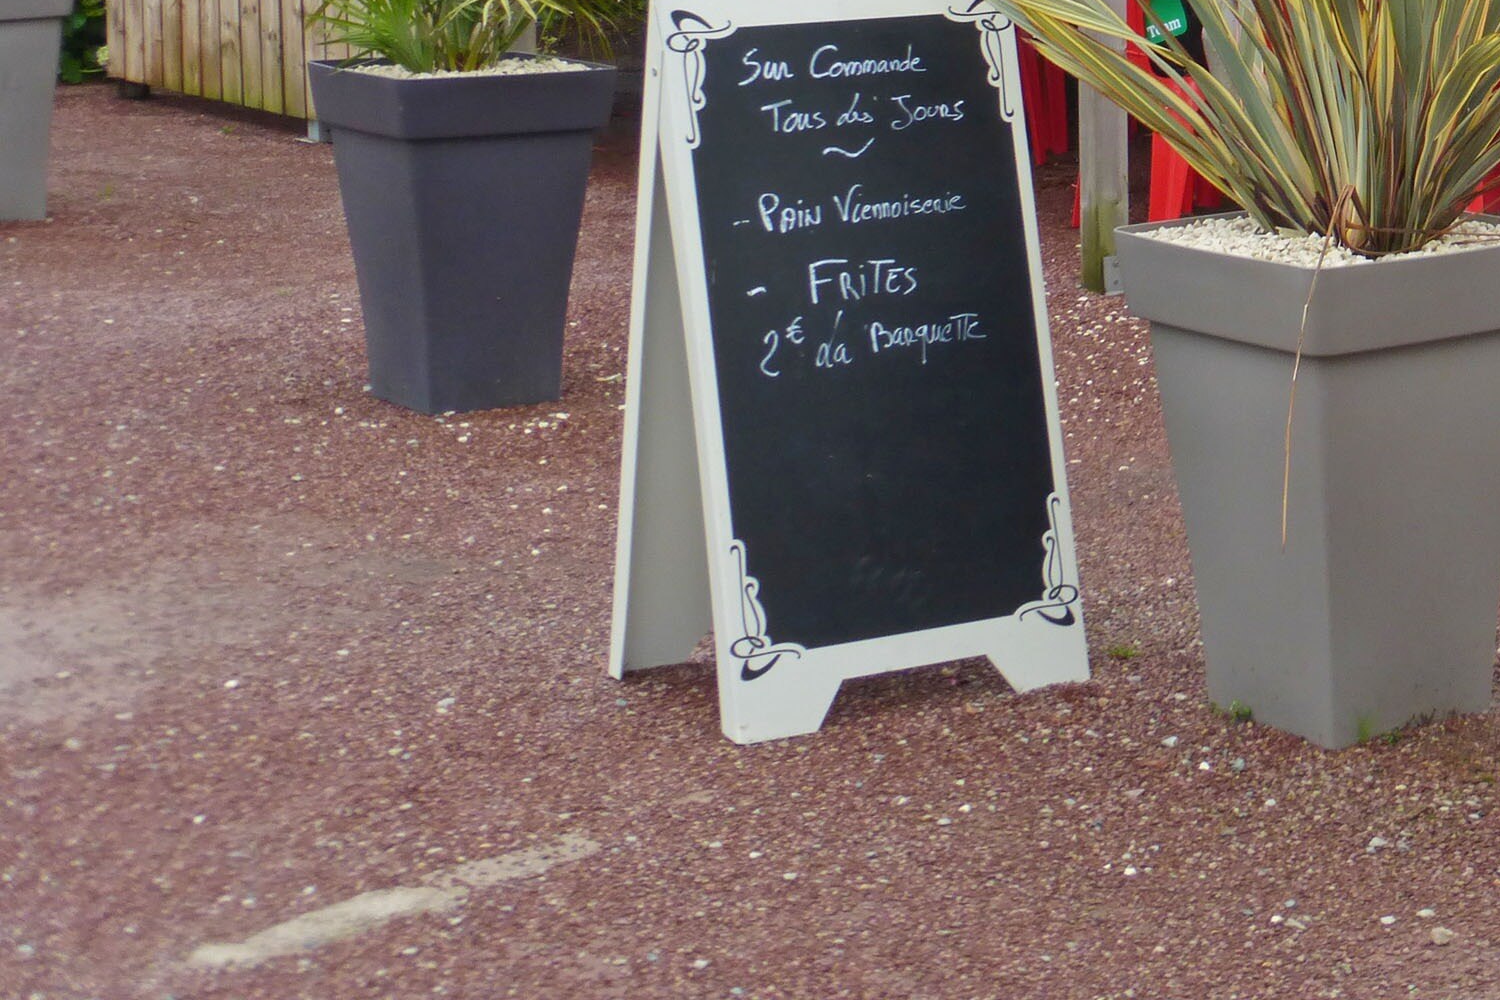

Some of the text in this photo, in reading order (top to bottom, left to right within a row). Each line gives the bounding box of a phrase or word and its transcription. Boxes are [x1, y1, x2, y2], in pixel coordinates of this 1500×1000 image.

[738, 44, 927, 86] Sur Commande
[760, 99, 827, 133] Tous
